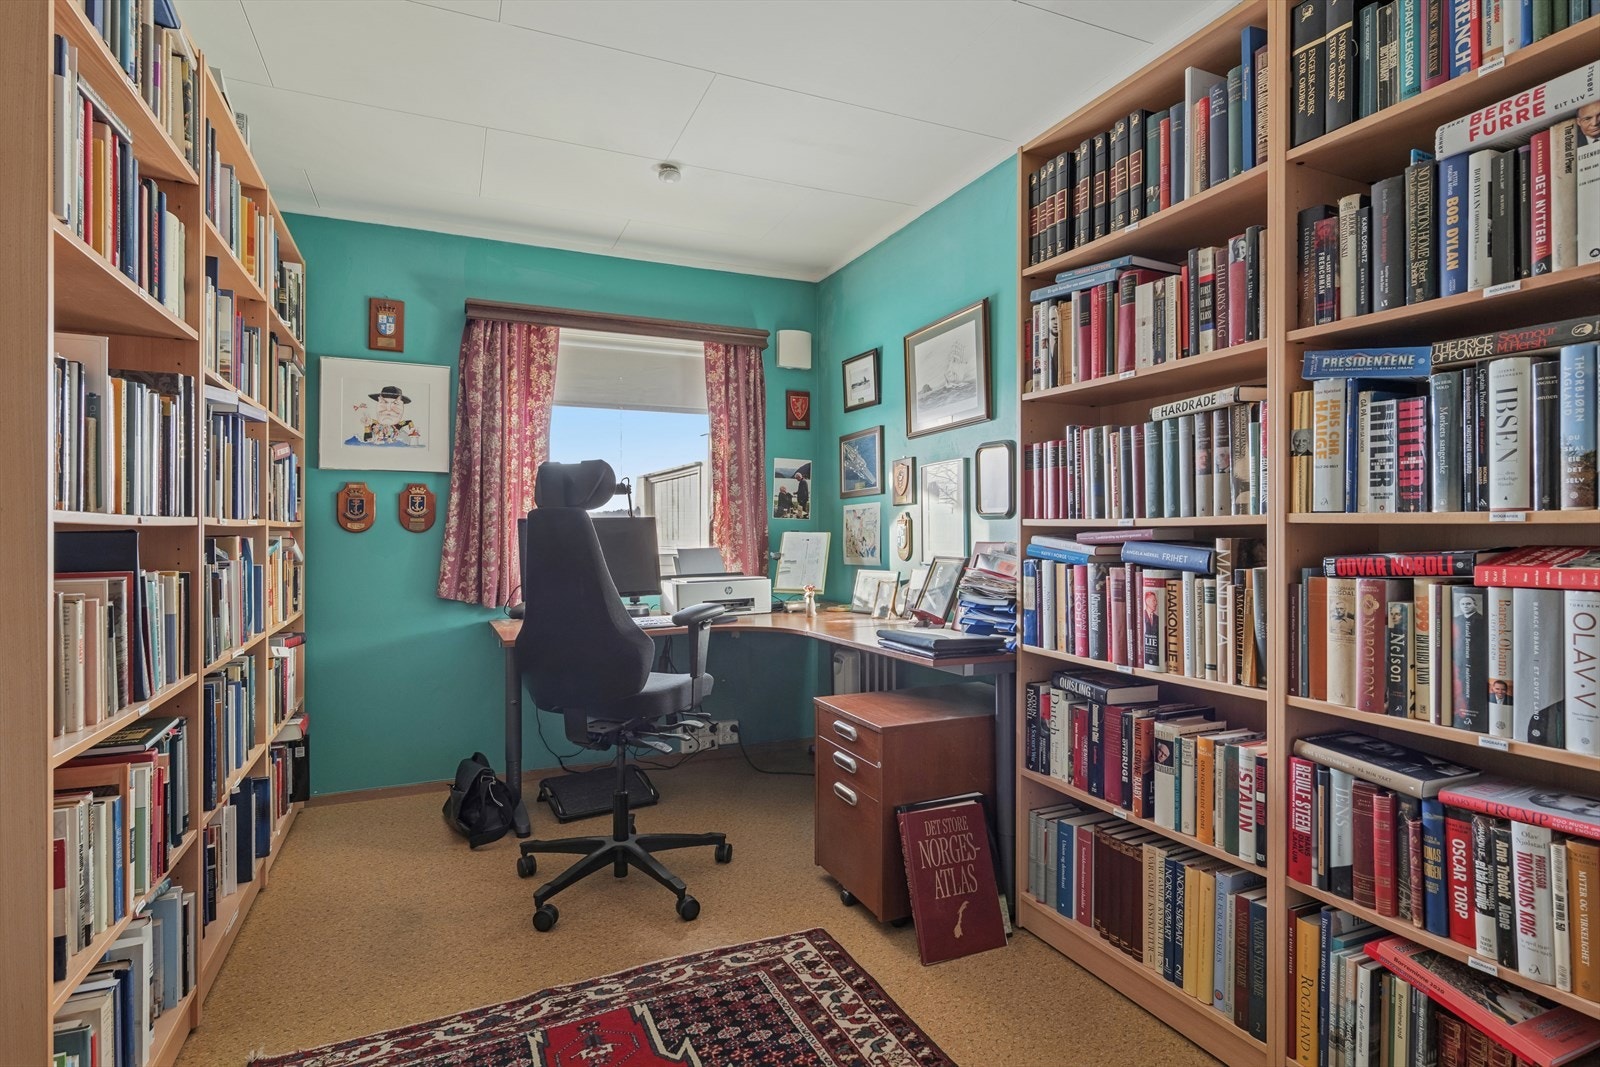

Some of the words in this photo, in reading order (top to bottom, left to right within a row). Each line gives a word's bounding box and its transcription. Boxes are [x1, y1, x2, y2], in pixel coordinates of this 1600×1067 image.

[1338, 32, 1346, 103] NORSK-ENGELSK
[1470, 85, 1547, 126] BERGE
[1554, 100, 1568, 110] EIT
[1571, 94, 1586, 103] LIV
[1469, 100, 1546, 142] FURRE
[1566, 124, 1574, 134] The
[1418, 167, 1430, 181] NO
[1564, 160, 1573, 174] Power
[1535, 175, 1546, 195] DET
[1131, 208, 1139, 217] 10
[1418, 182, 1430, 229] DIRECTION
[1446, 196, 1458, 224] BOB
[1535, 198, 1546, 244] NYTTER
[1418, 230, 1429, 258] HOME
[1446, 227, 1458, 271] DYLAN
[1217, 264, 1225, 310] HILLARYS
[1304, 268, 1309, 277] DA
[1411, 262, 1419, 286] Shelton
[1418, 260, 1427, 282] Robert
[1434, 344, 1456, 356] THE
[1458, 335, 1494, 348] PRICE
[1499, 327, 1557, 341] Seymour
[1509, 339, 1547, 351] Hersh
[1322, 354, 1416, 368] PRESIDENTENE
[1432, 353, 1449, 363] OF
[1449, 343, 1494, 360] POWER
[1564, 367, 1572, 416] JAGLAND
[1575, 356, 1584, 423] THORBJØRN
[1315, 401, 1327, 459] HAUGE
[1329, 399, 1340, 427] JENS
[1439, 407, 1448, 442] Mørkets
[1496, 385, 1518, 464] IBSEN
[1329, 432, 1338, 459] CHR.
[1370, 404, 1394, 487] HITLER
[1399, 400, 1423, 486] HITLER
[1438, 444, 1449, 474] sangerske
[1162, 553, 1188, 563] FRIHET
[1336, 557, 1387, 576] ODVAR
[1391, 555, 1454, 576] NORDLI
[1090, 593, 1100, 631] Khrushchev
[1167, 583, 1178, 636] HAAKON
[1216, 550, 1231, 646] MANDELA
[1416, 596, 1429, 632] 1999
[1498, 599, 1511, 635] Barack
[1145, 638, 1158, 647] LIE
[1168, 641, 1178, 663] LIE
[1363, 617, 1376, 698] NAPOLEON
[1390, 632, 1406, 683] Nelson
[1416, 634, 1430, 665] RICHARD
[1499, 638, 1511, 677] Obama
[1573, 612, 1598, 683] OLAV
[1059, 677, 1091, 697] QUISLING
[1416, 666, 1430, 685] NIXON
[1051, 693, 1059, 735] Dutch
[1574, 692, 1597, 709] V
[1295, 764, 1311, 799] REIULF
[1239, 772, 1253, 832] STALIN
[1296, 800, 1311, 834] STEEN
[1334, 787, 1350, 828] JENS
[1447, 796, 1470, 807] MARY
[1481, 800, 1549, 825] TRUMP
[924, 818, 941, 837] DET
[943, 816, 969, 834] STORE
[1521, 830, 1540, 840] Olav
[918, 832, 980, 869] NORGES-
[1452, 838, 1468, 881] OSCAR
[1496, 840, 1508, 863] Arne
[935, 863, 978, 900] ATLAS
[1497, 865, 1510, 899] Treholt
[1517, 851, 1533, 908] TRONSTADS
[1536, 855, 1547, 889] PROFESSOR
[1579, 871, 1587, 898] MYTER
[1454, 885, 1468, 919] TORP
[1498, 902, 1511, 930] Alene
[1580, 899, 1588, 911] OG
[1175, 908, 1183, 948] SJØFART
[1238, 910, 1247, 947] NARVIKS
[1254, 918, 1263, 956] NARVIKS
[1520, 910, 1536, 938] KRIG
[1556, 922, 1565, 931] 50
[1580, 913, 1590, 966] VIRKELIGHET
[1238, 948, 1247, 988] HISTORIE
[1253, 957, 1264, 998] HISTORIE
[1393, 956, 1430, 984] Borreminne
[1300, 975, 1314, 1052] ROGALAND
